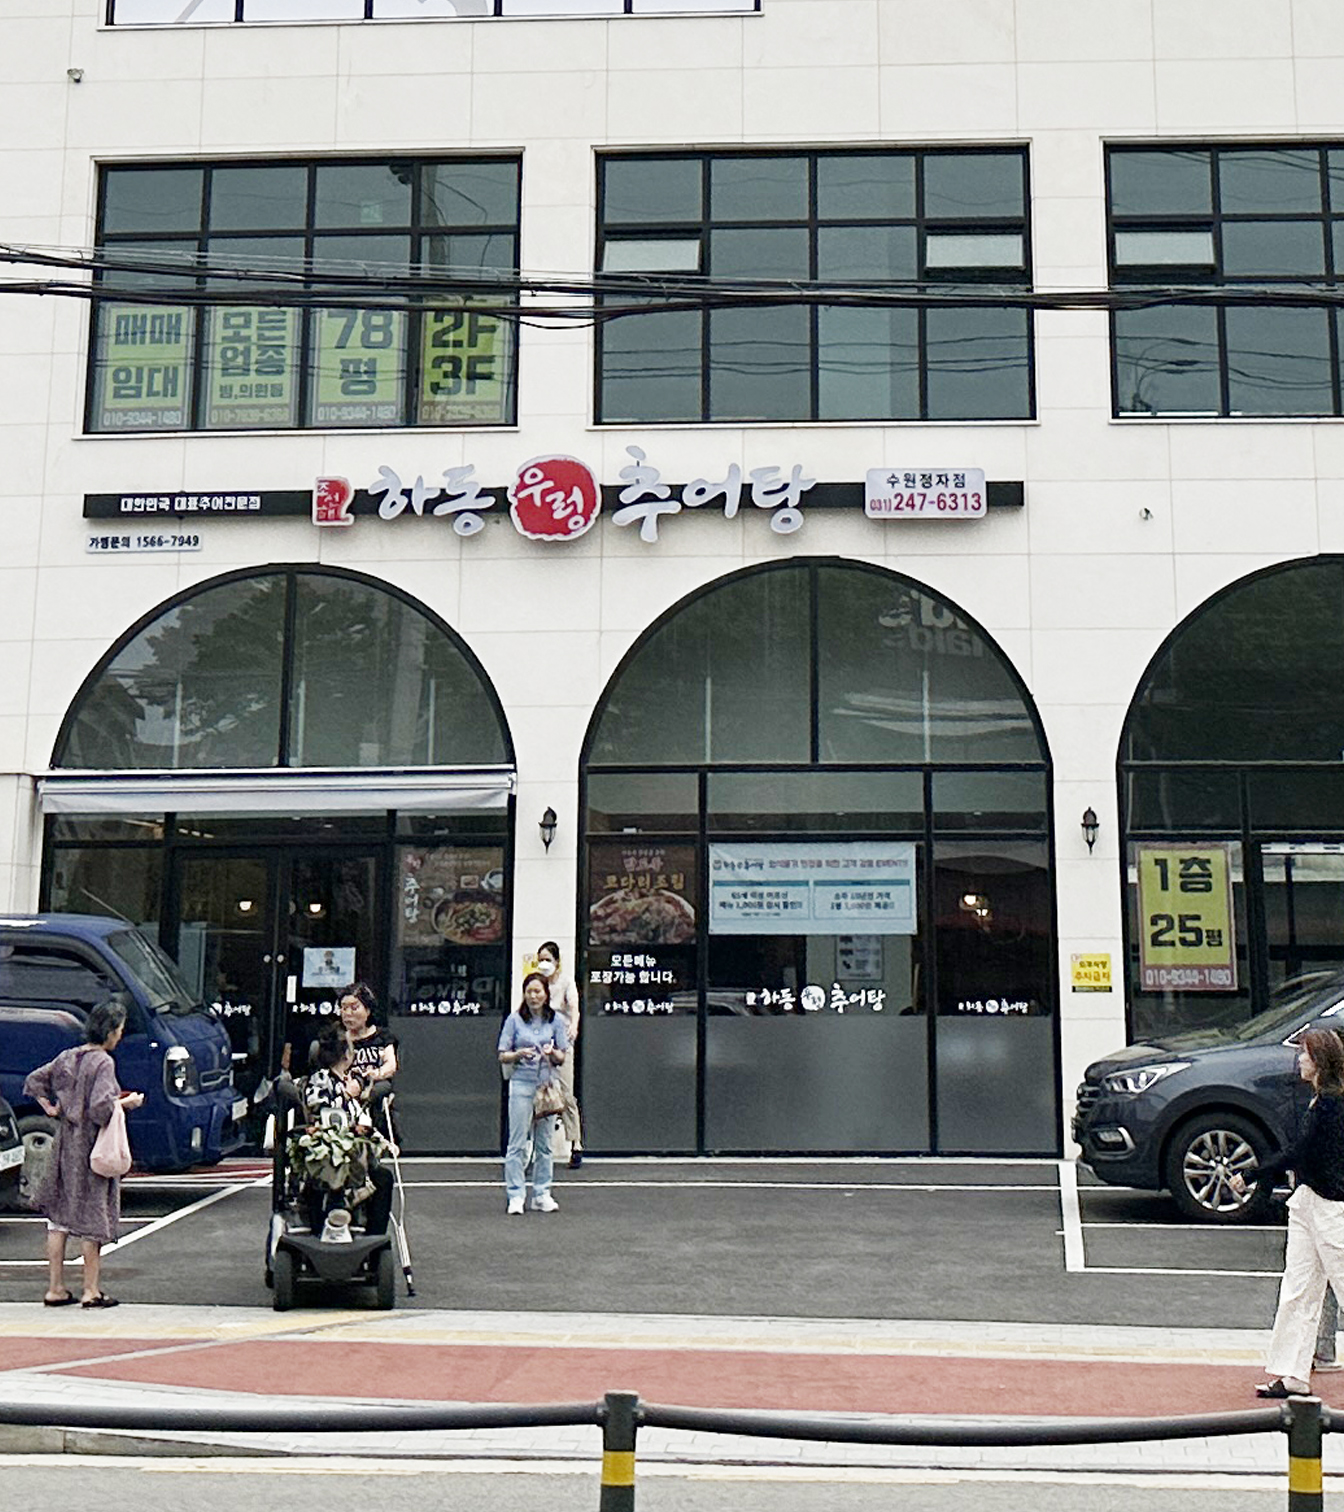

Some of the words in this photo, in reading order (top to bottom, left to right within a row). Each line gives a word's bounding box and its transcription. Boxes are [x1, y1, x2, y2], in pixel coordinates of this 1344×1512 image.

[115, 313, 183, 345] 매매
[221, 310, 287, 343] 모든
[326, 310, 394, 349] 78
[431, 311, 499, 349] 2F
[219, 344, 287, 378] 업종
[339, 357, 378, 396] 평
[430, 355, 497, 395] 3F
[112, 366, 179, 399] 임대
[367, 464, 497, 537] 하동
[517, 467, 587, 532] 우렁
[611, 444, 819, 543] 추어탕
[886, 472, 967, 489] 수원정자점
[829, 982, 887, 1014] 추어탕
